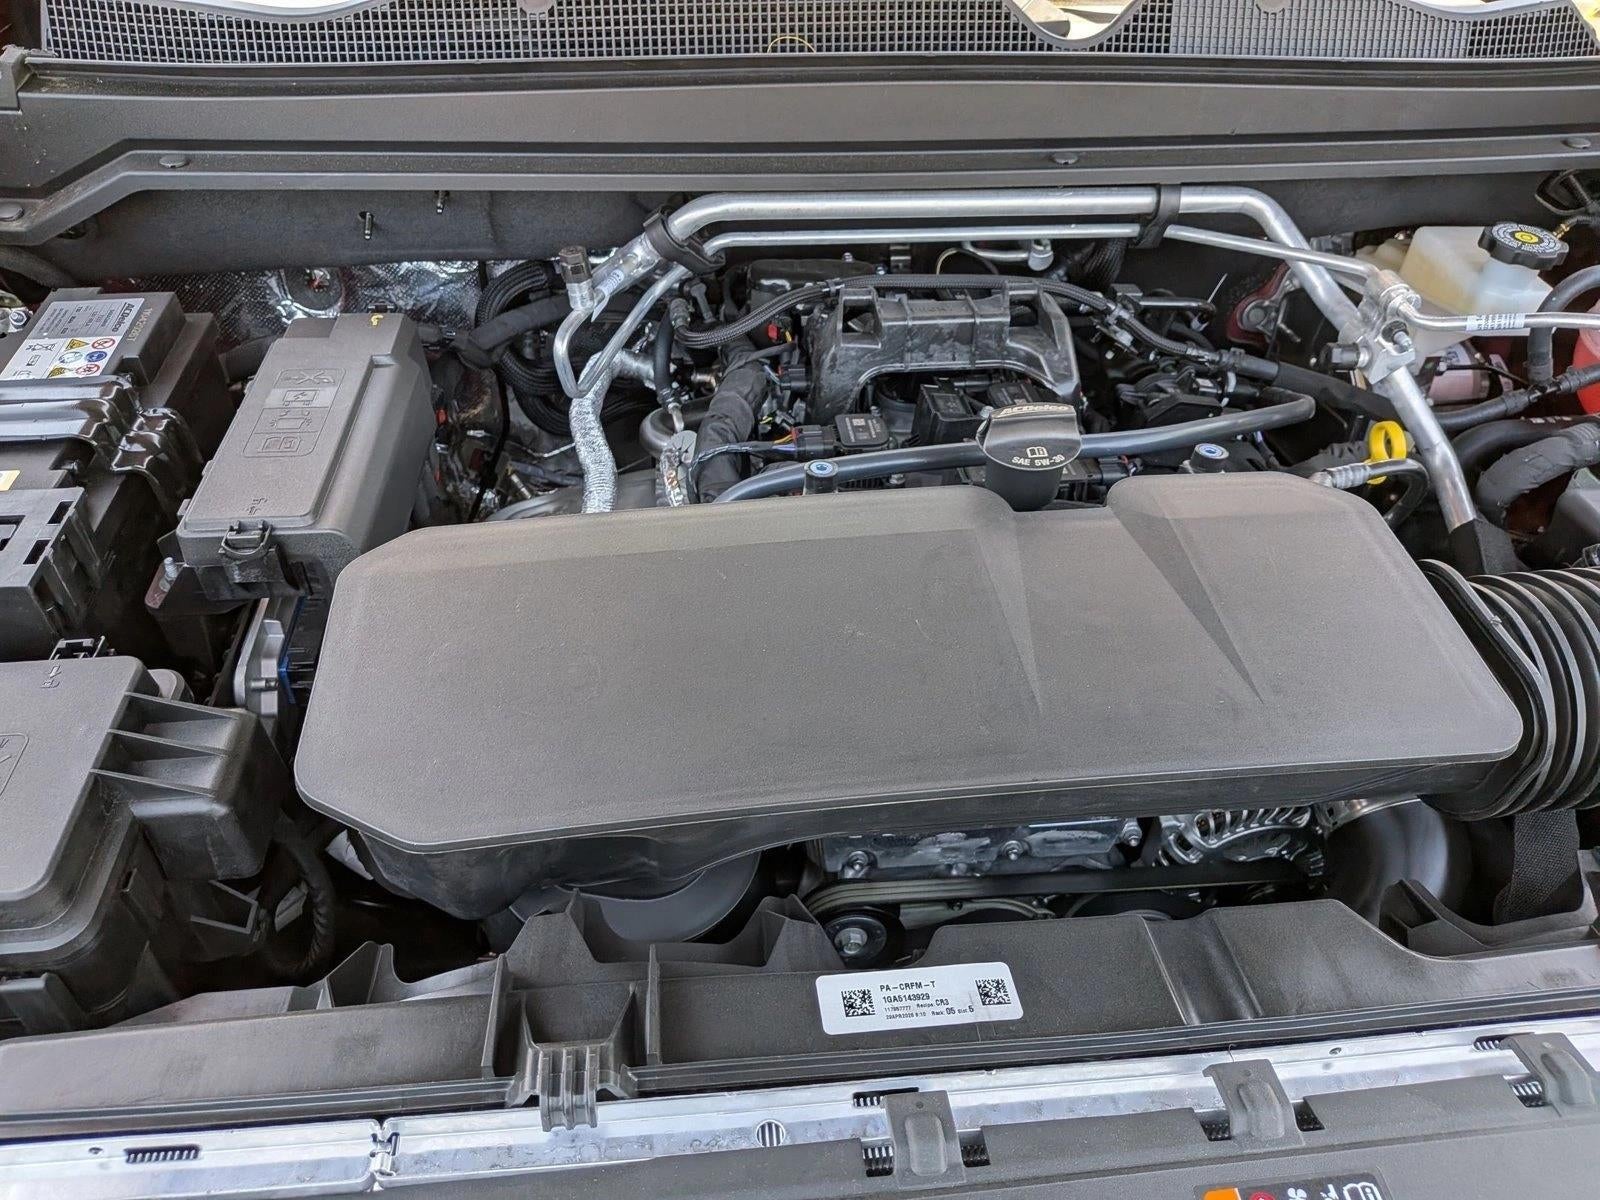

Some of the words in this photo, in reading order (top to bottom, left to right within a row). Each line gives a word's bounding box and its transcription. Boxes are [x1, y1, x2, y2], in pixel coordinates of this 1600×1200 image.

[111, 302, 135, 332] ACDelco
[1012, 456, 1031, 466] SAE
[1035, 454, 1065, 467] 5W-30
[880, 981, 936, 993] PA-CRFM-T
[935, 999, 949, 1007] CR3
[946, 1006, 956, 1015] 05
[968, 1005, 975, 1013] 5
